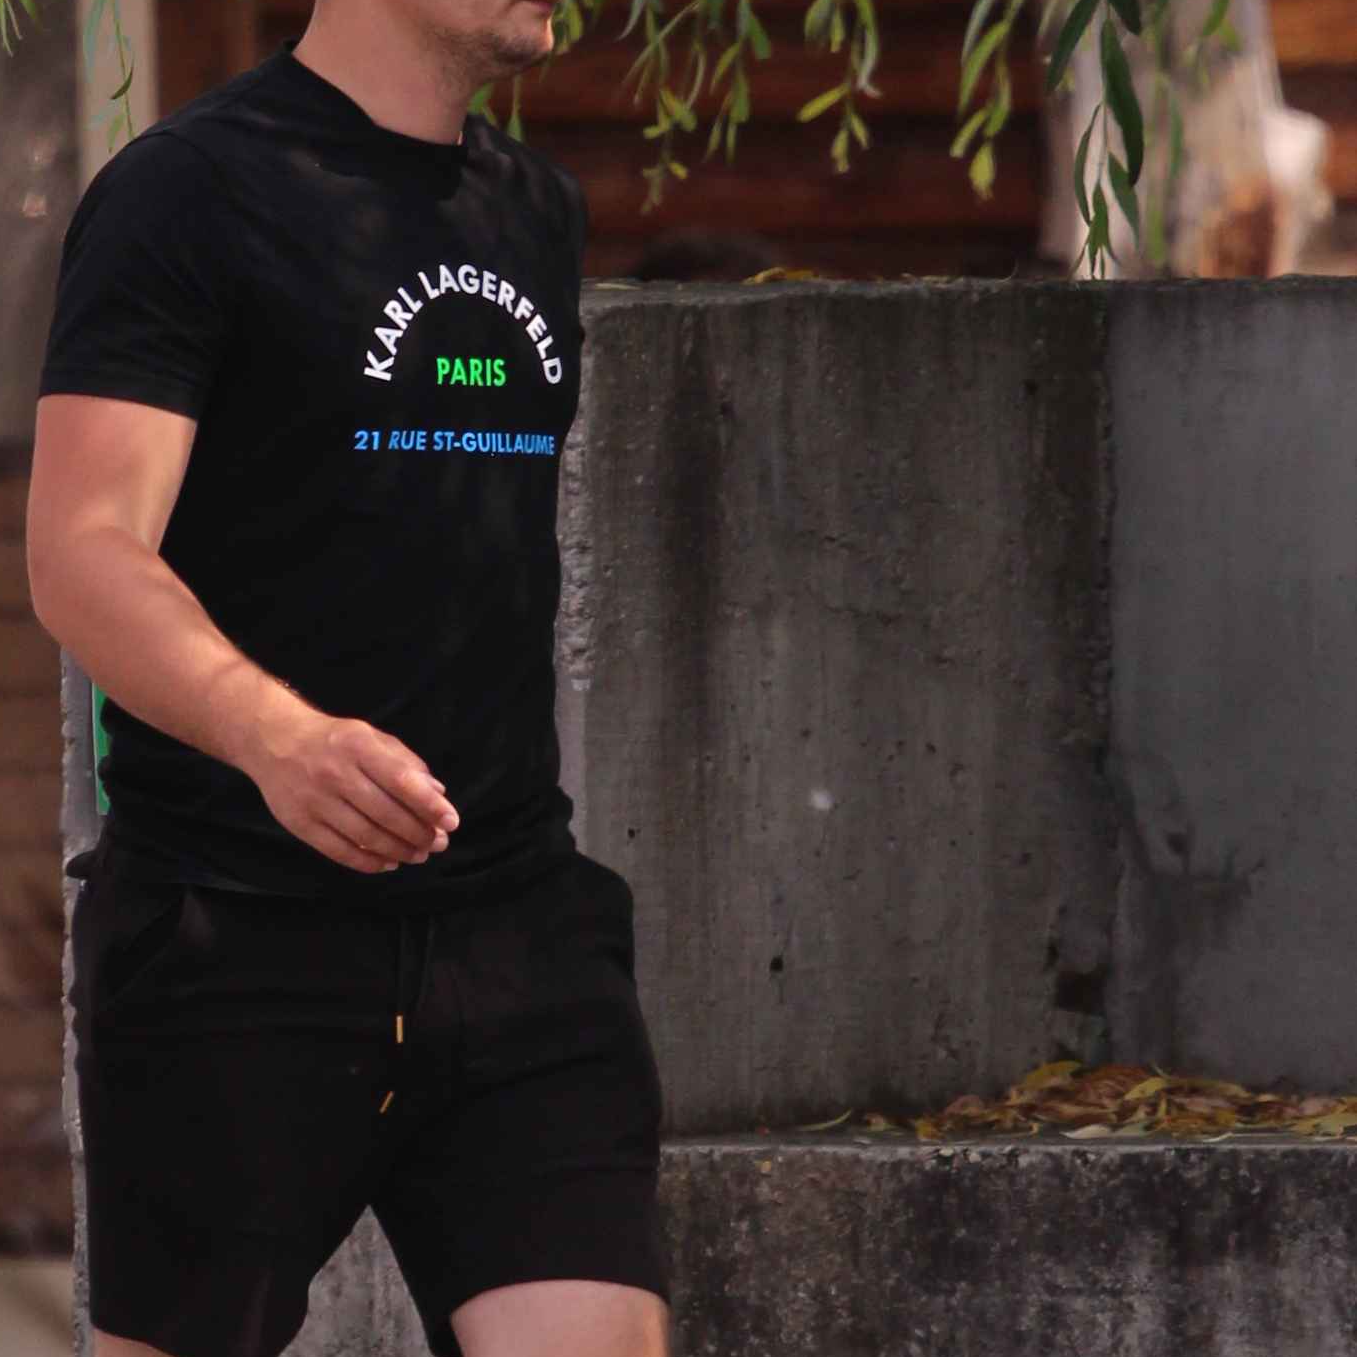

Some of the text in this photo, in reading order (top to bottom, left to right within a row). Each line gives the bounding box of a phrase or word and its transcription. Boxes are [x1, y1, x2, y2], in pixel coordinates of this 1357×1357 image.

[363, 263, 563, 385] KARL LAGERFELD
[436, 357, 507, 387] PARIS
[354, 429, 555, 456] 21 RUE ST-GUILLAUME
